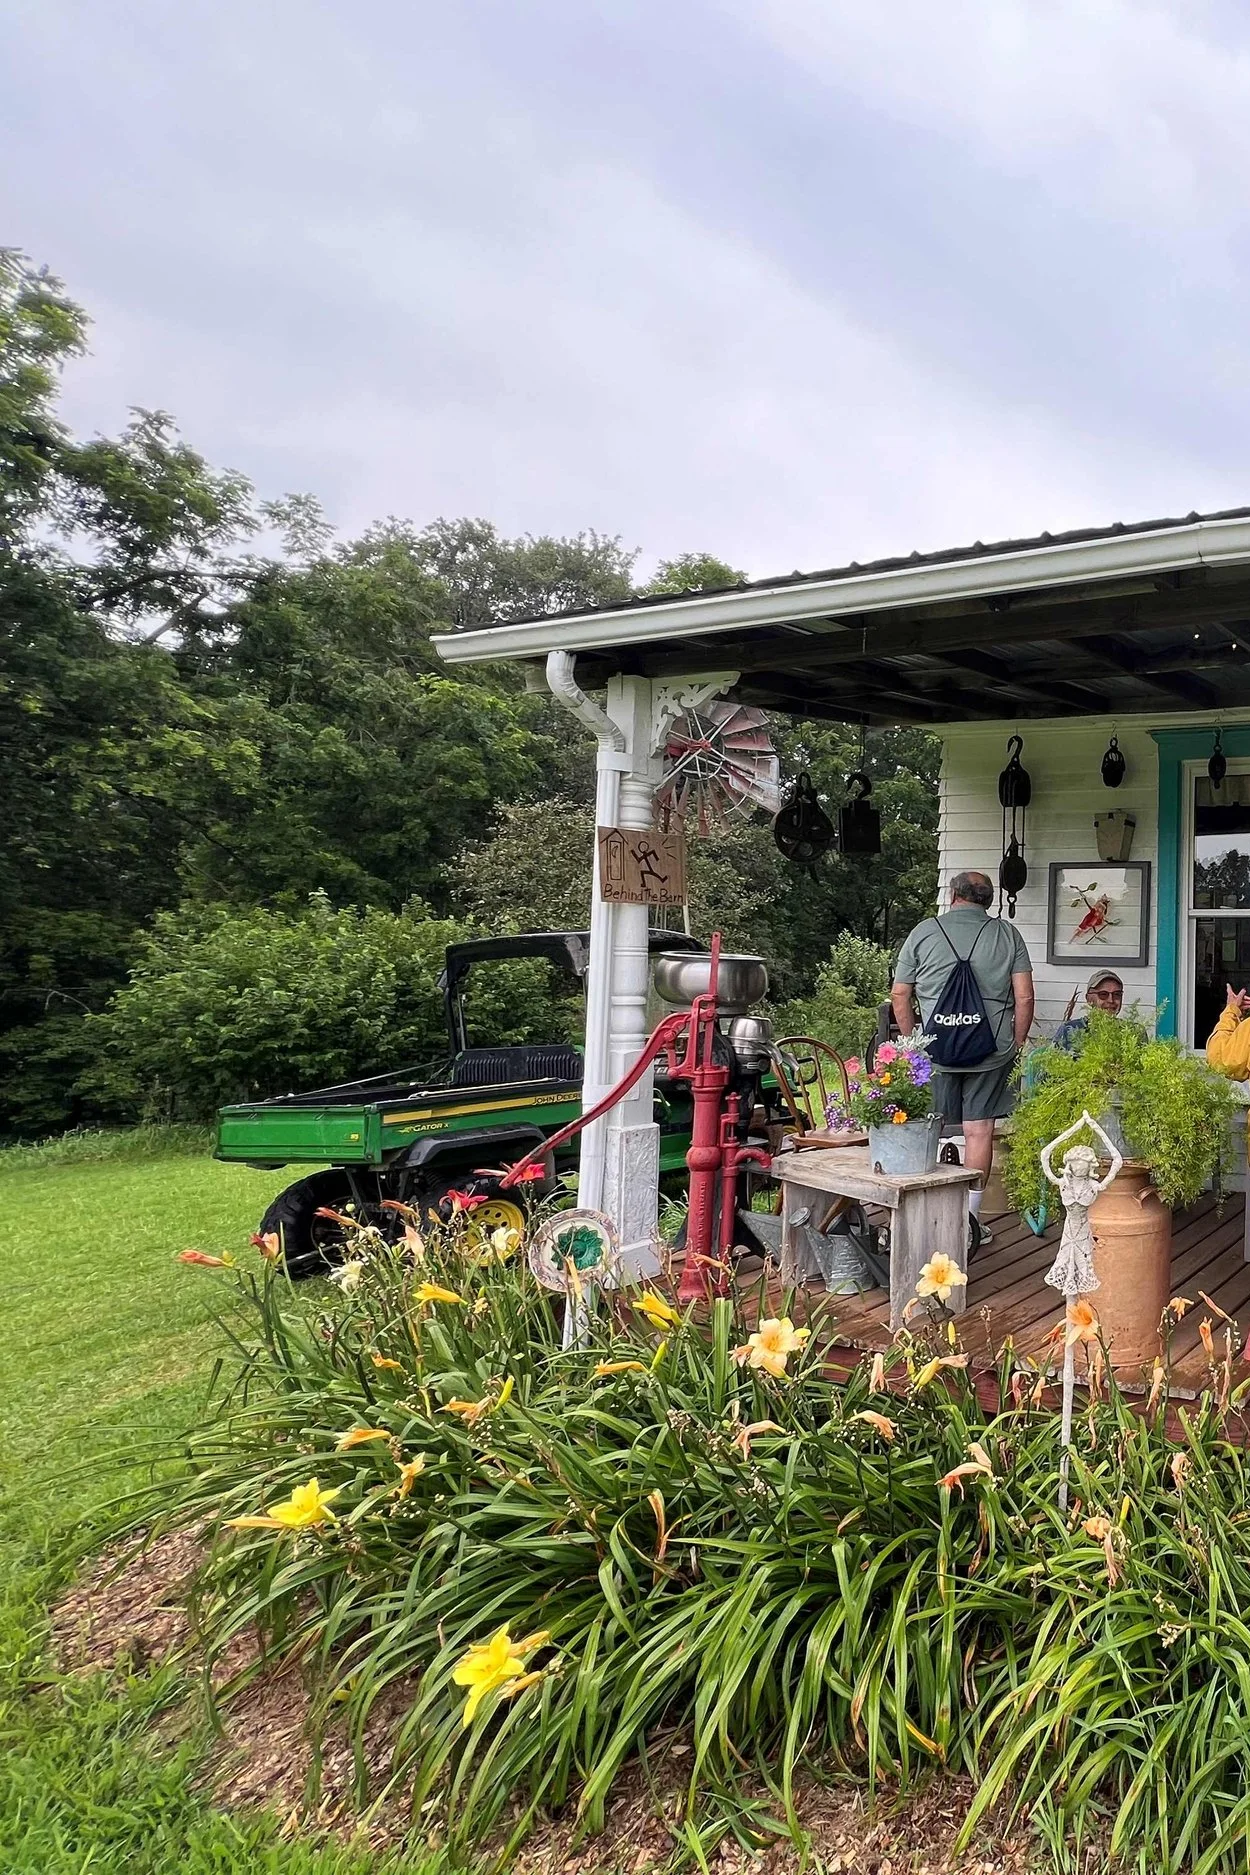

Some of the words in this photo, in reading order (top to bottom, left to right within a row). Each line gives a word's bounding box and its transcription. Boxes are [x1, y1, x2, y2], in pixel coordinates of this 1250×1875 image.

[603, 883, 643, 901] Behind
[644, 888, 658, 902] The
[659, 888, 684, 904] Barn
[933, 1012, 982, 1026] adidas
[532, 1095, 555, 1106] JOHN
[413, 1122, 443, 1132] GATOR
